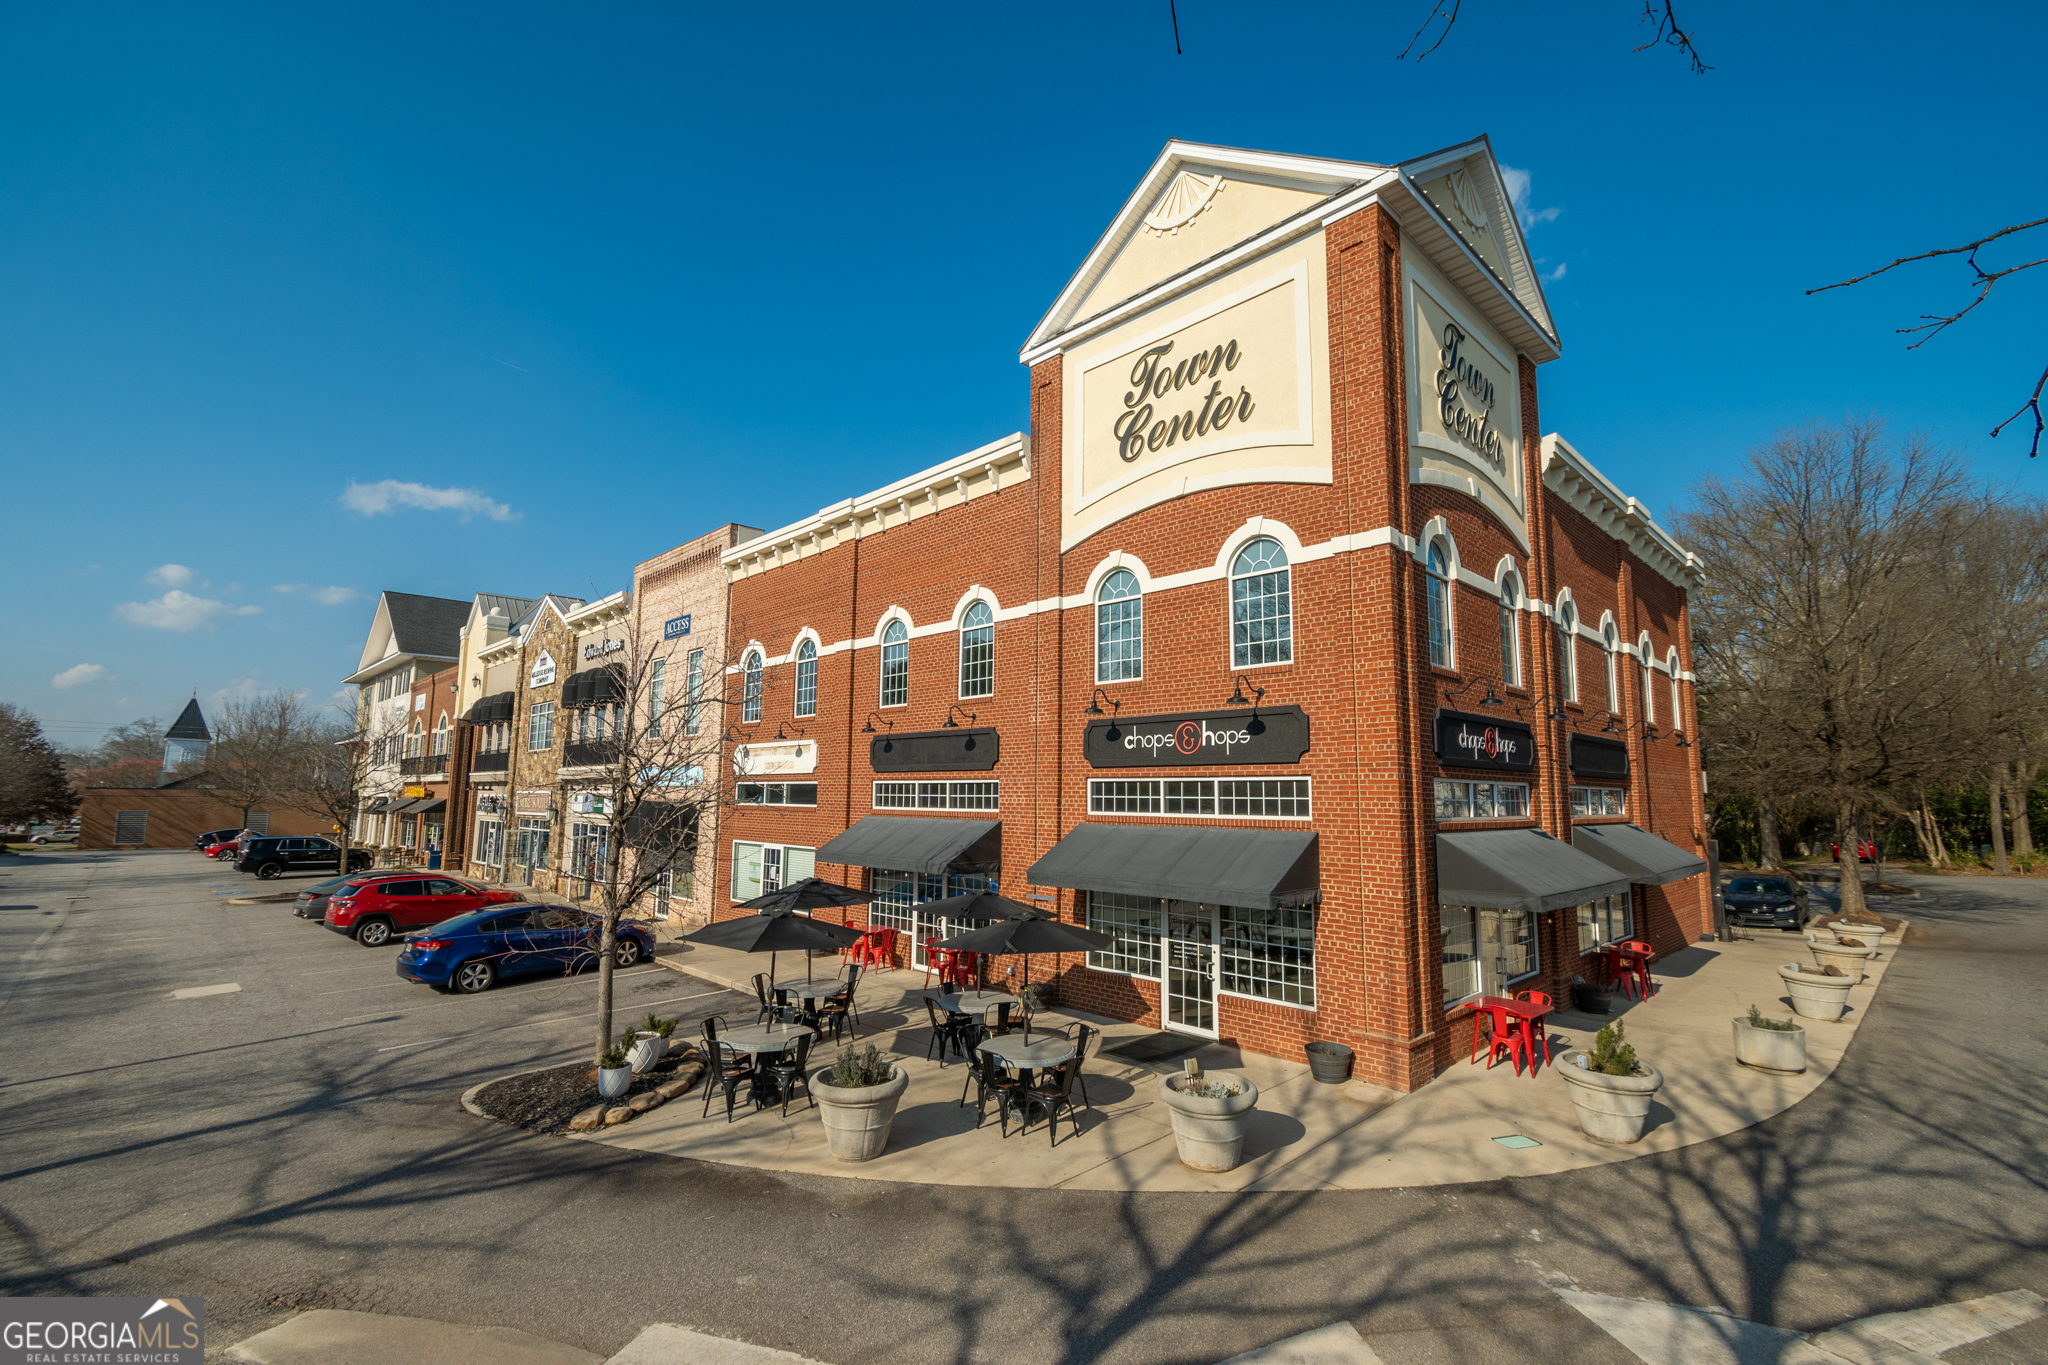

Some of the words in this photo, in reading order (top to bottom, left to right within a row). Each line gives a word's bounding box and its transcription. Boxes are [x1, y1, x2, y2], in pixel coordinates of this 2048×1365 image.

[1123, 338, 1243, 409] Town
[1440, 322, 1496, 409] Town
[1113, 379, 1256, 463] Center
[1434, 368, 1504, 464] Center
[665, 617, 690, 635] ACCESS
[1124, 725, 1175, 757] chops
[1202, 720, 1250, 755] hops
